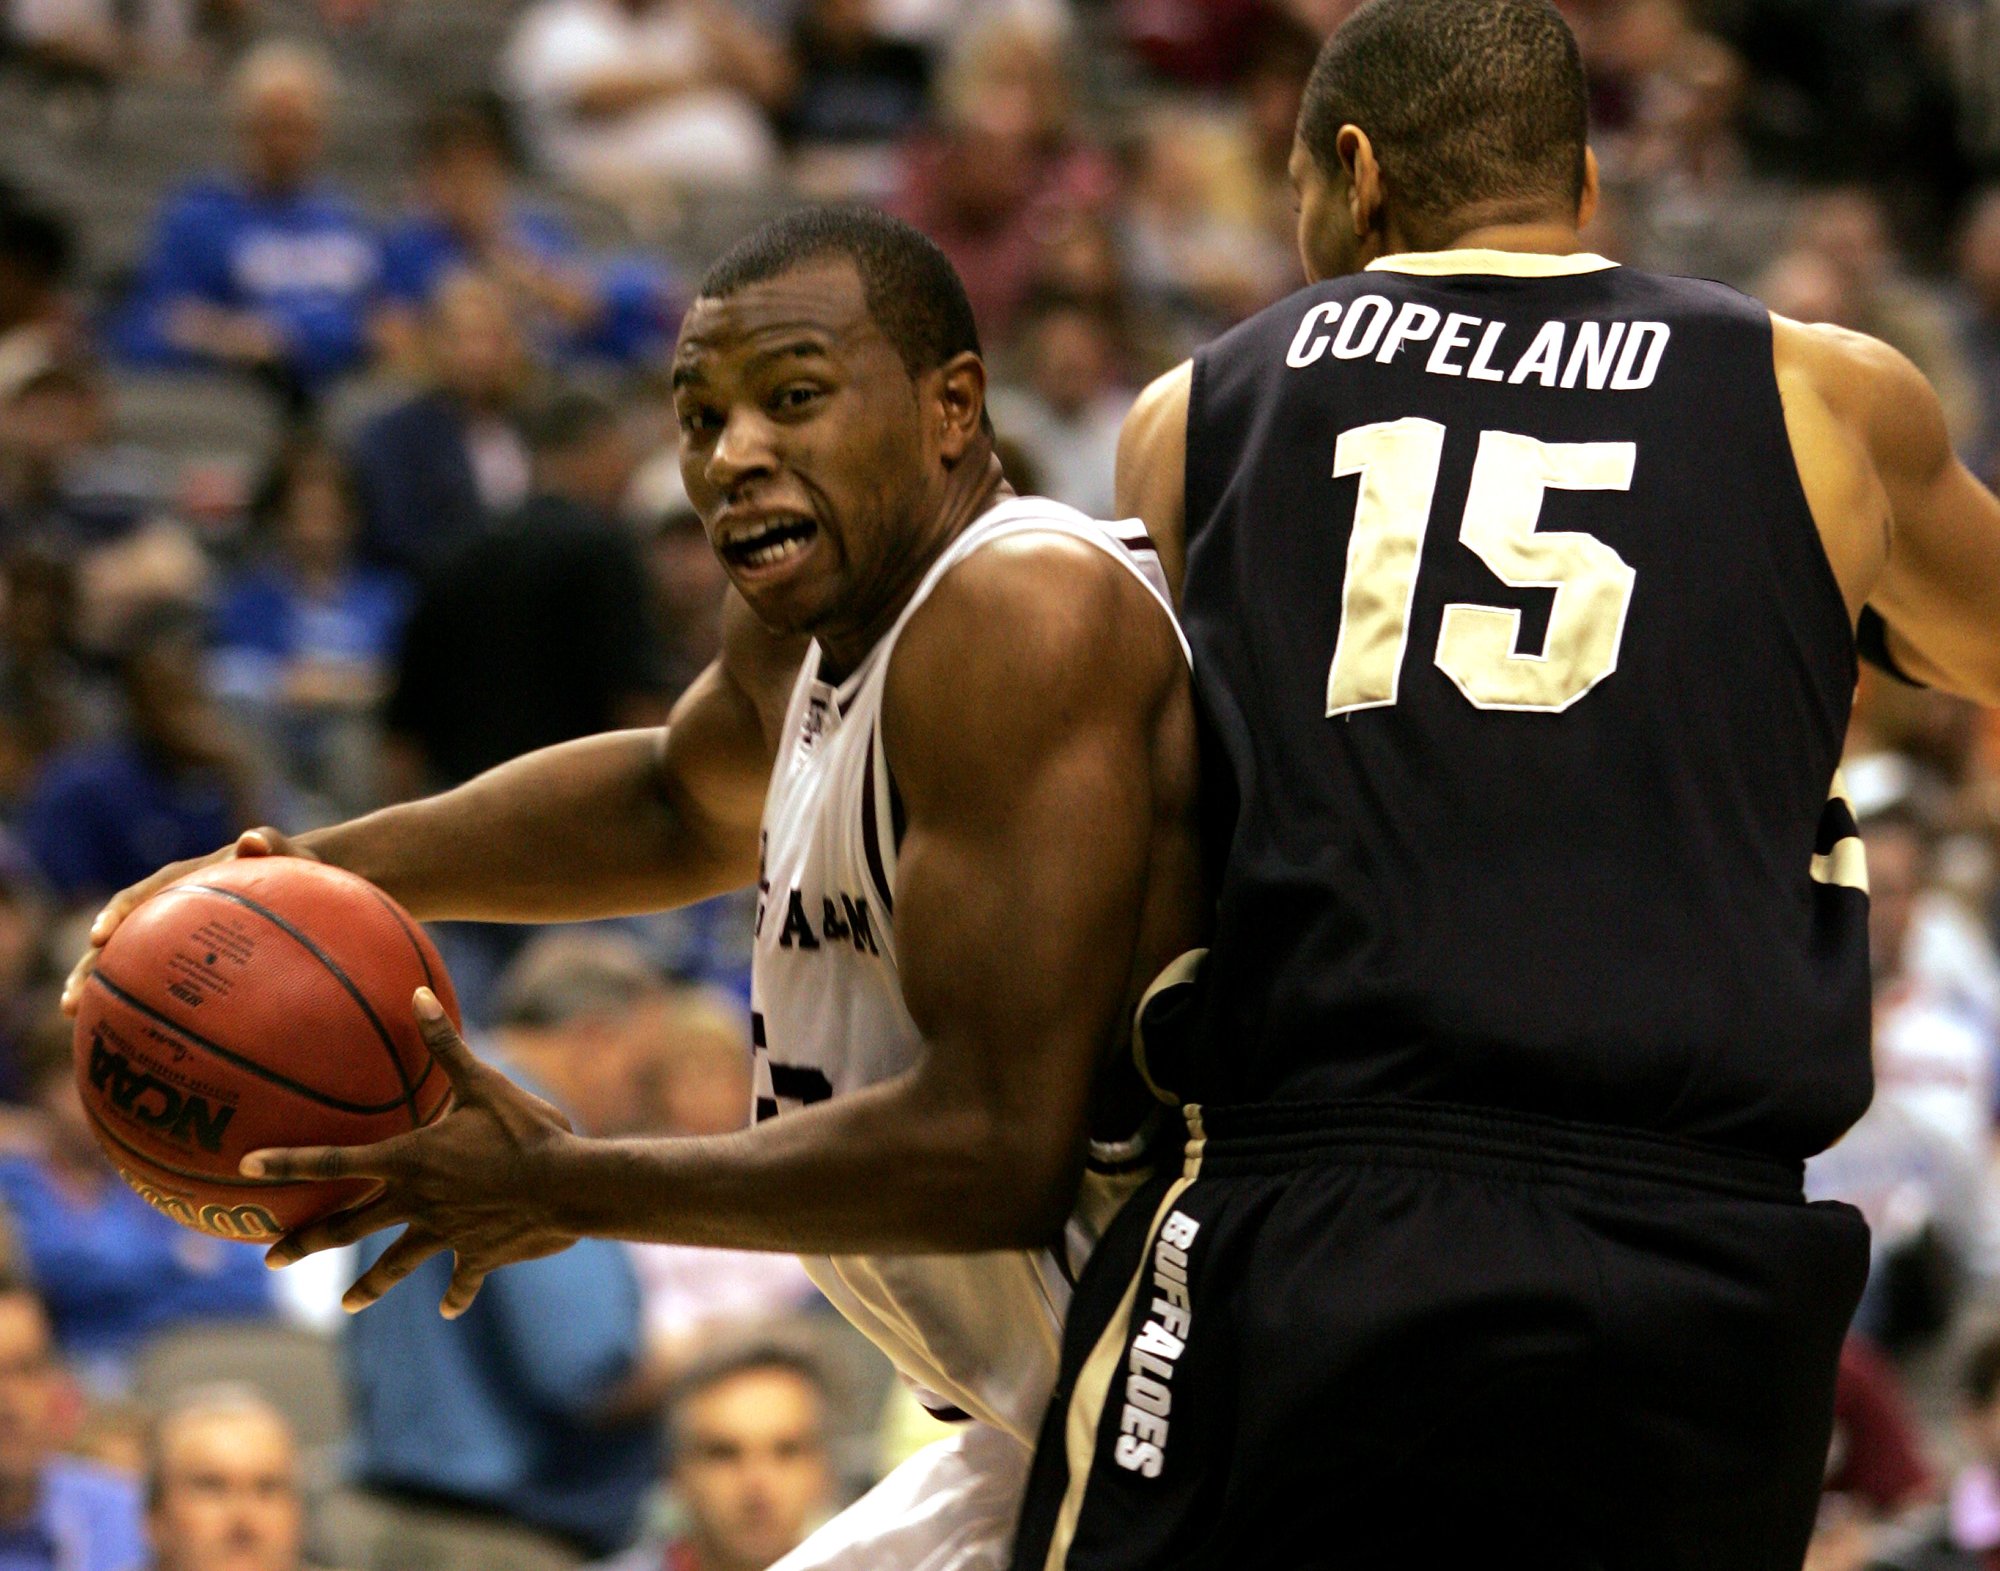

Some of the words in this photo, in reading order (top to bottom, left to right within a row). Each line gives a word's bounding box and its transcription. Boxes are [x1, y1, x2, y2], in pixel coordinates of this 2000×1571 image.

[1286, 294, 1671, 391] COPELAND
[1326, 416, 1637, 719] 15
[88, 1034, 238, 1154] NCAA
[1114, 1210, 1200, 1479] BUFFALOES
